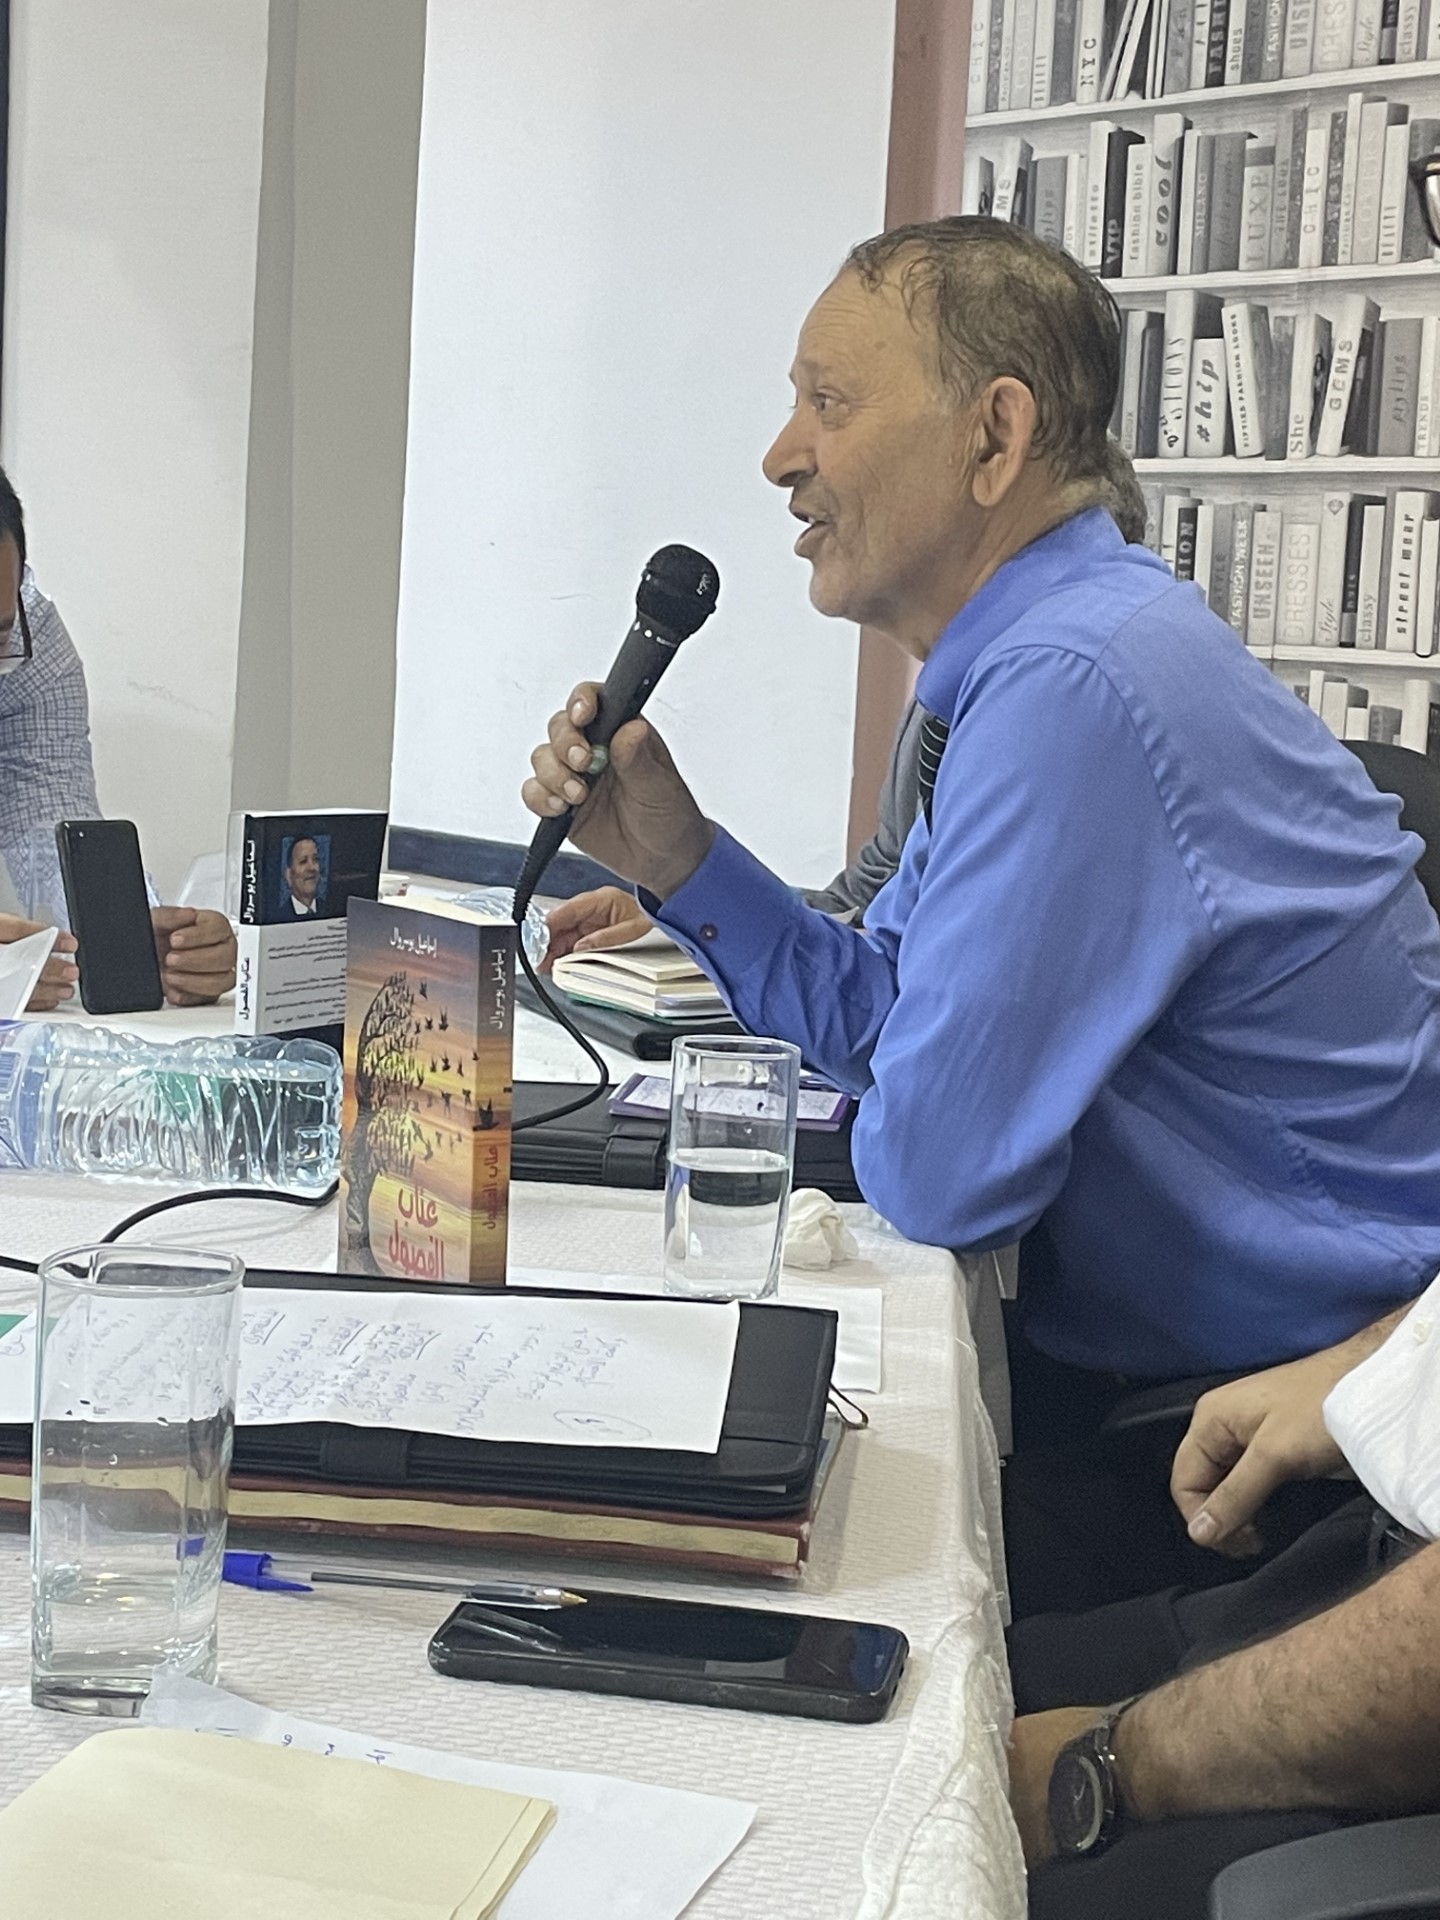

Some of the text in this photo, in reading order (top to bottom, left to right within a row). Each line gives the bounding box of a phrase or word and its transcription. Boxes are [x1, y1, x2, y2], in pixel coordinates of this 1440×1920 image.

[1080, 37, 1097, 87] NYC
[1228, 28, 1243, 72] shoes
[1398, 5, 1417, 56] classy
[1128, 162, 1144, 261] fashion bible
[1154, 155, 1173, 247] cool
[1246, 173, 1270, 264] LUXE
[1302, 165, 1320, 234] CHIC
[1105, 218, 1122, 265] VIP
[1194, 358, 1219, 444] #hip
[1230, 312, 1250, 449] FIFTIES FASHION LOOKS
[1328, 338, 1353, 411] GEMS
[1289, 413, 1305, 454] She
[1252, 543, 1275, 620] UNSEEN
[1283, 533, 1311, 640] DRESSES
[1394, 513, 1415, 634] street wear
[1318, 598, 1338, 643] Style
[1358, 593, 1377, 643] classy
